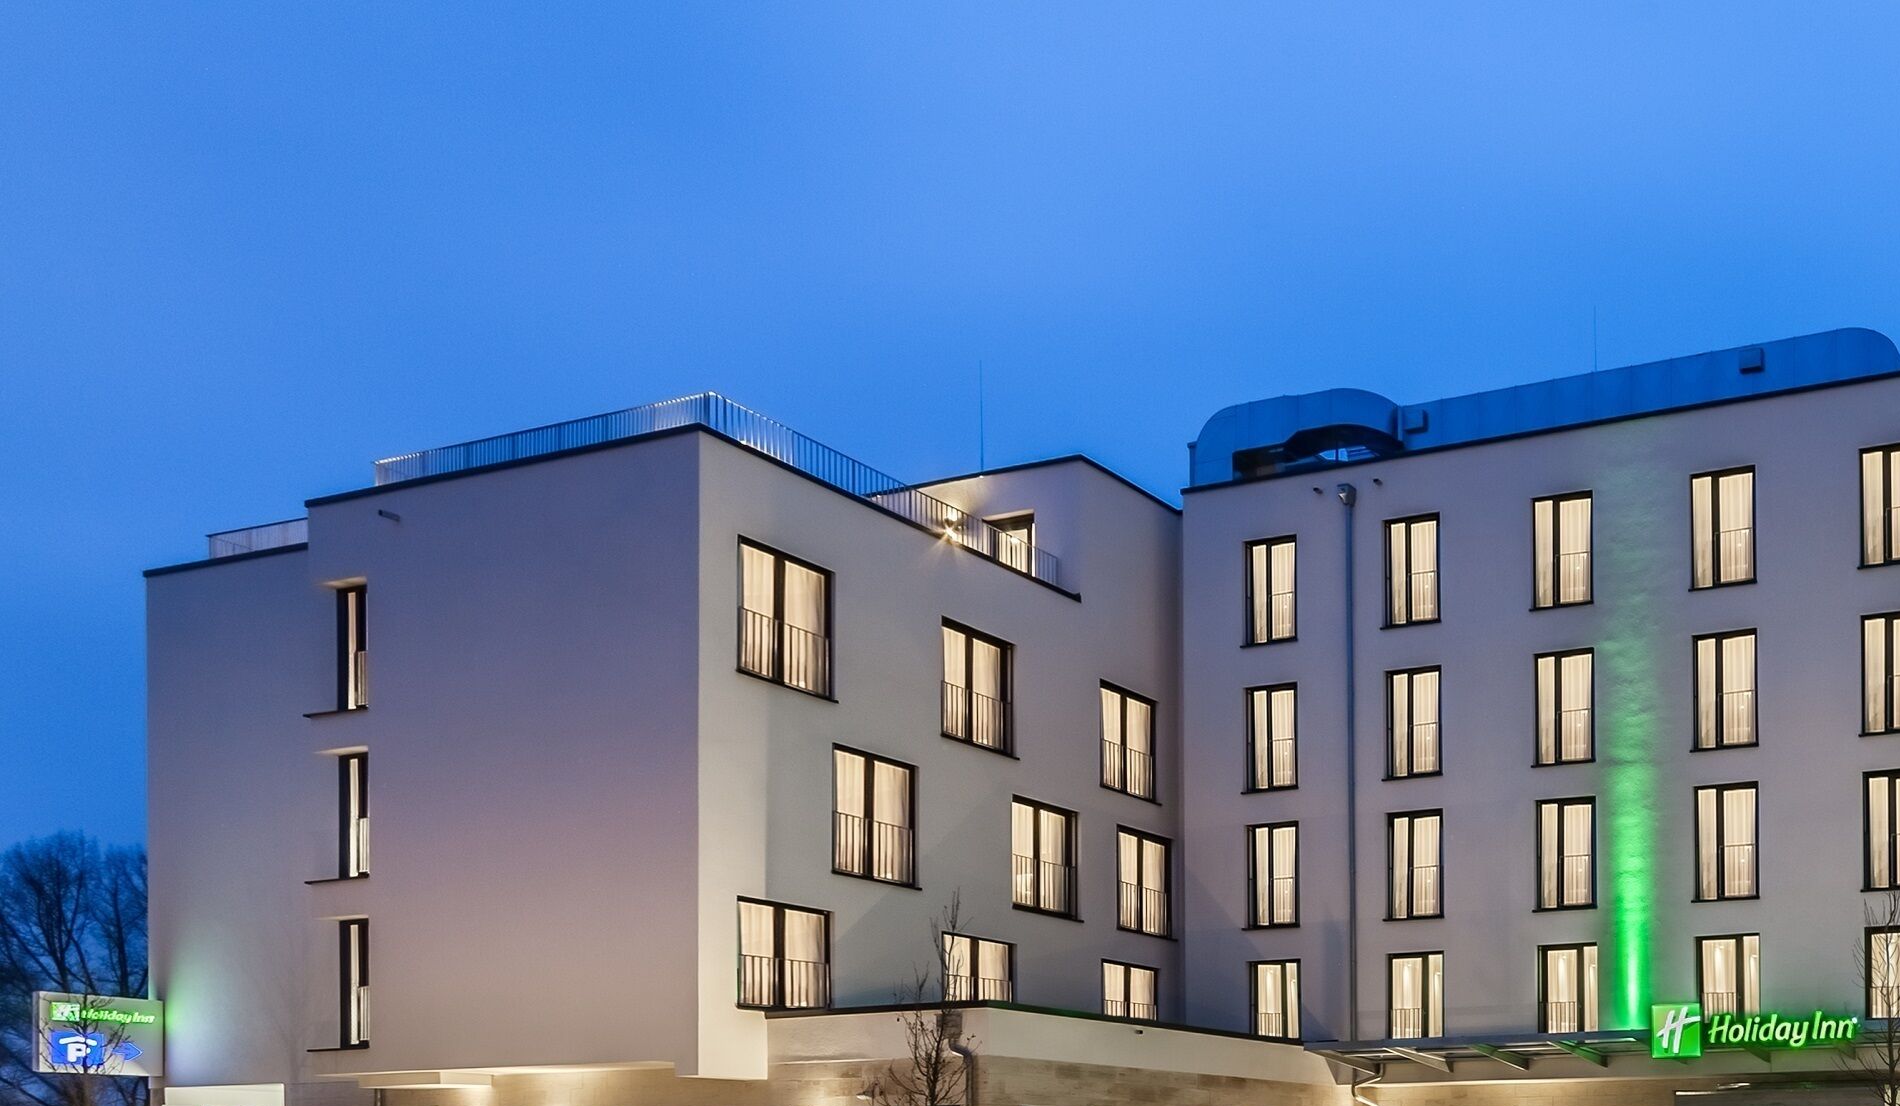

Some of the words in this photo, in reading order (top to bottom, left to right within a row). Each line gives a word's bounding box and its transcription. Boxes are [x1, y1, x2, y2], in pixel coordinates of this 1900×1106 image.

[1708, 1013, 1809, 1047] Holiday
[1812, 1010, 1854, 1040] Inn
[67, 1043, 91, 1062] P
